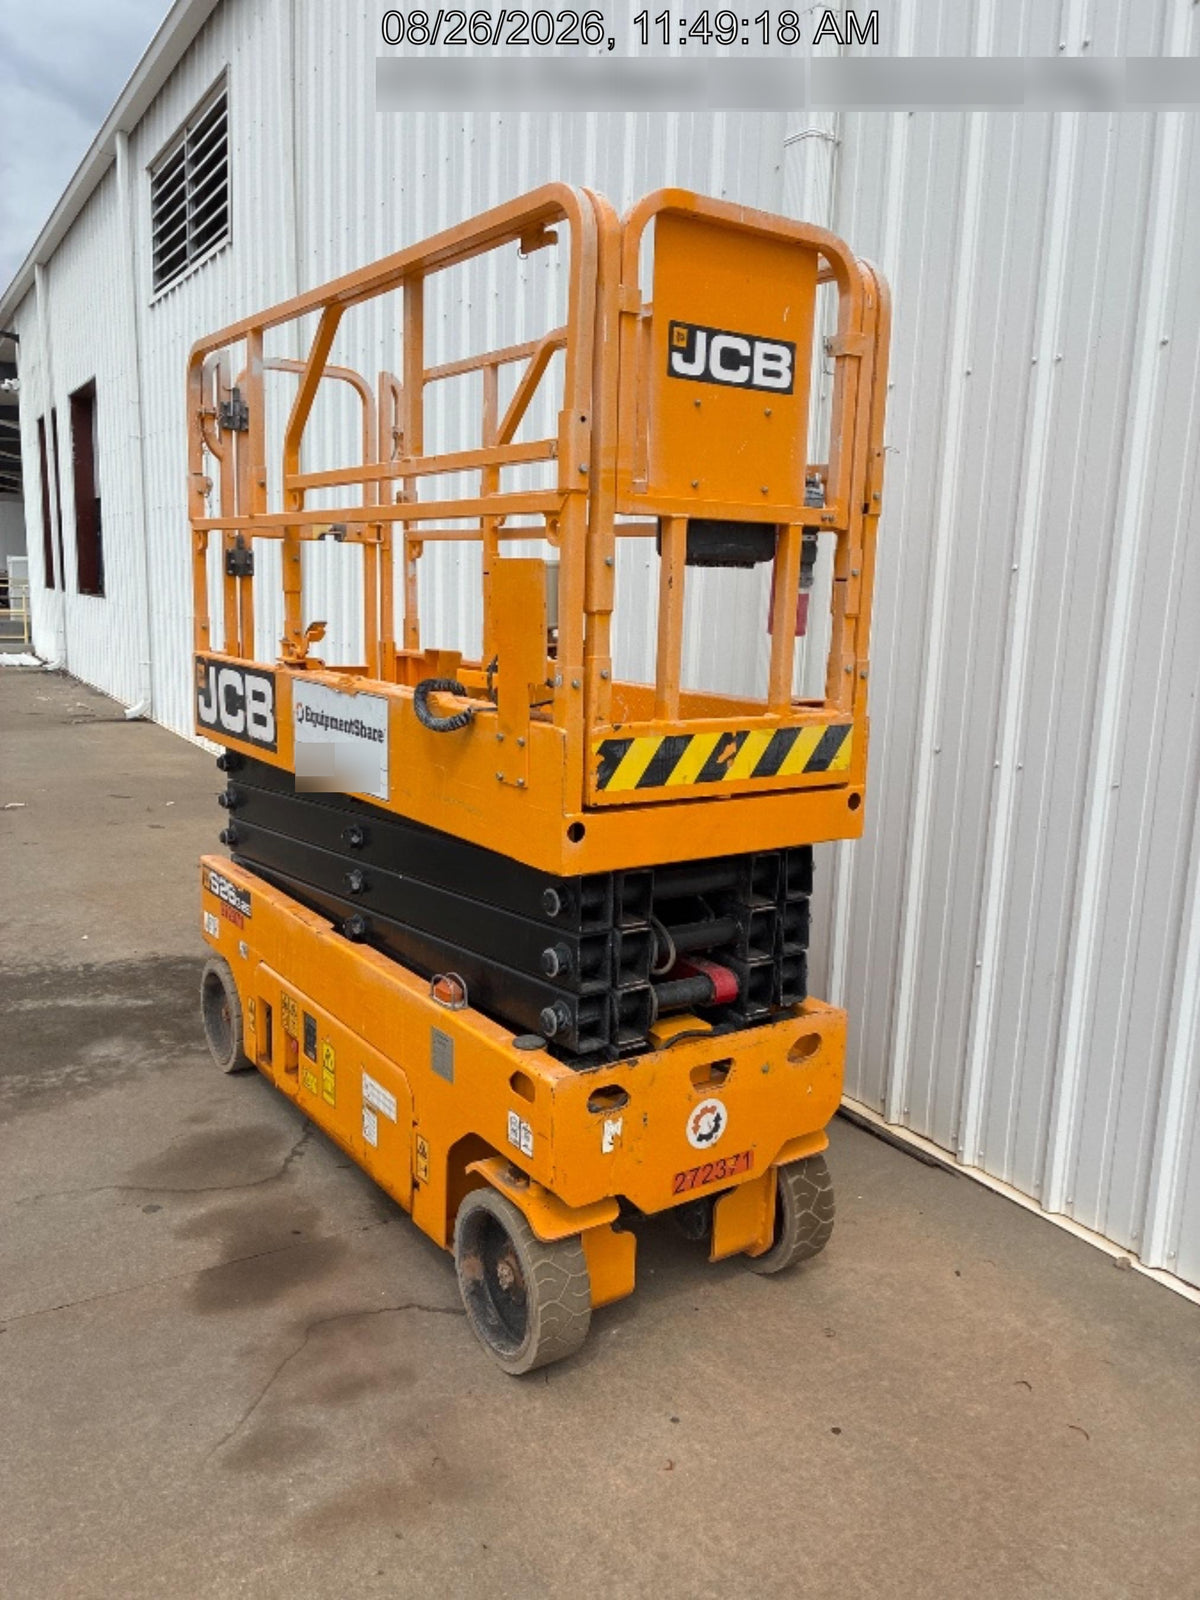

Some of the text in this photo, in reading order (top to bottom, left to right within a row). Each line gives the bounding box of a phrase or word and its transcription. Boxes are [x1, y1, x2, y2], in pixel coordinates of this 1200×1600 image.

[671, 329, 793, 389] JCB
[198, 665, 276, 744] JCB
[304, 704, 385, 744] EquipmentShare
